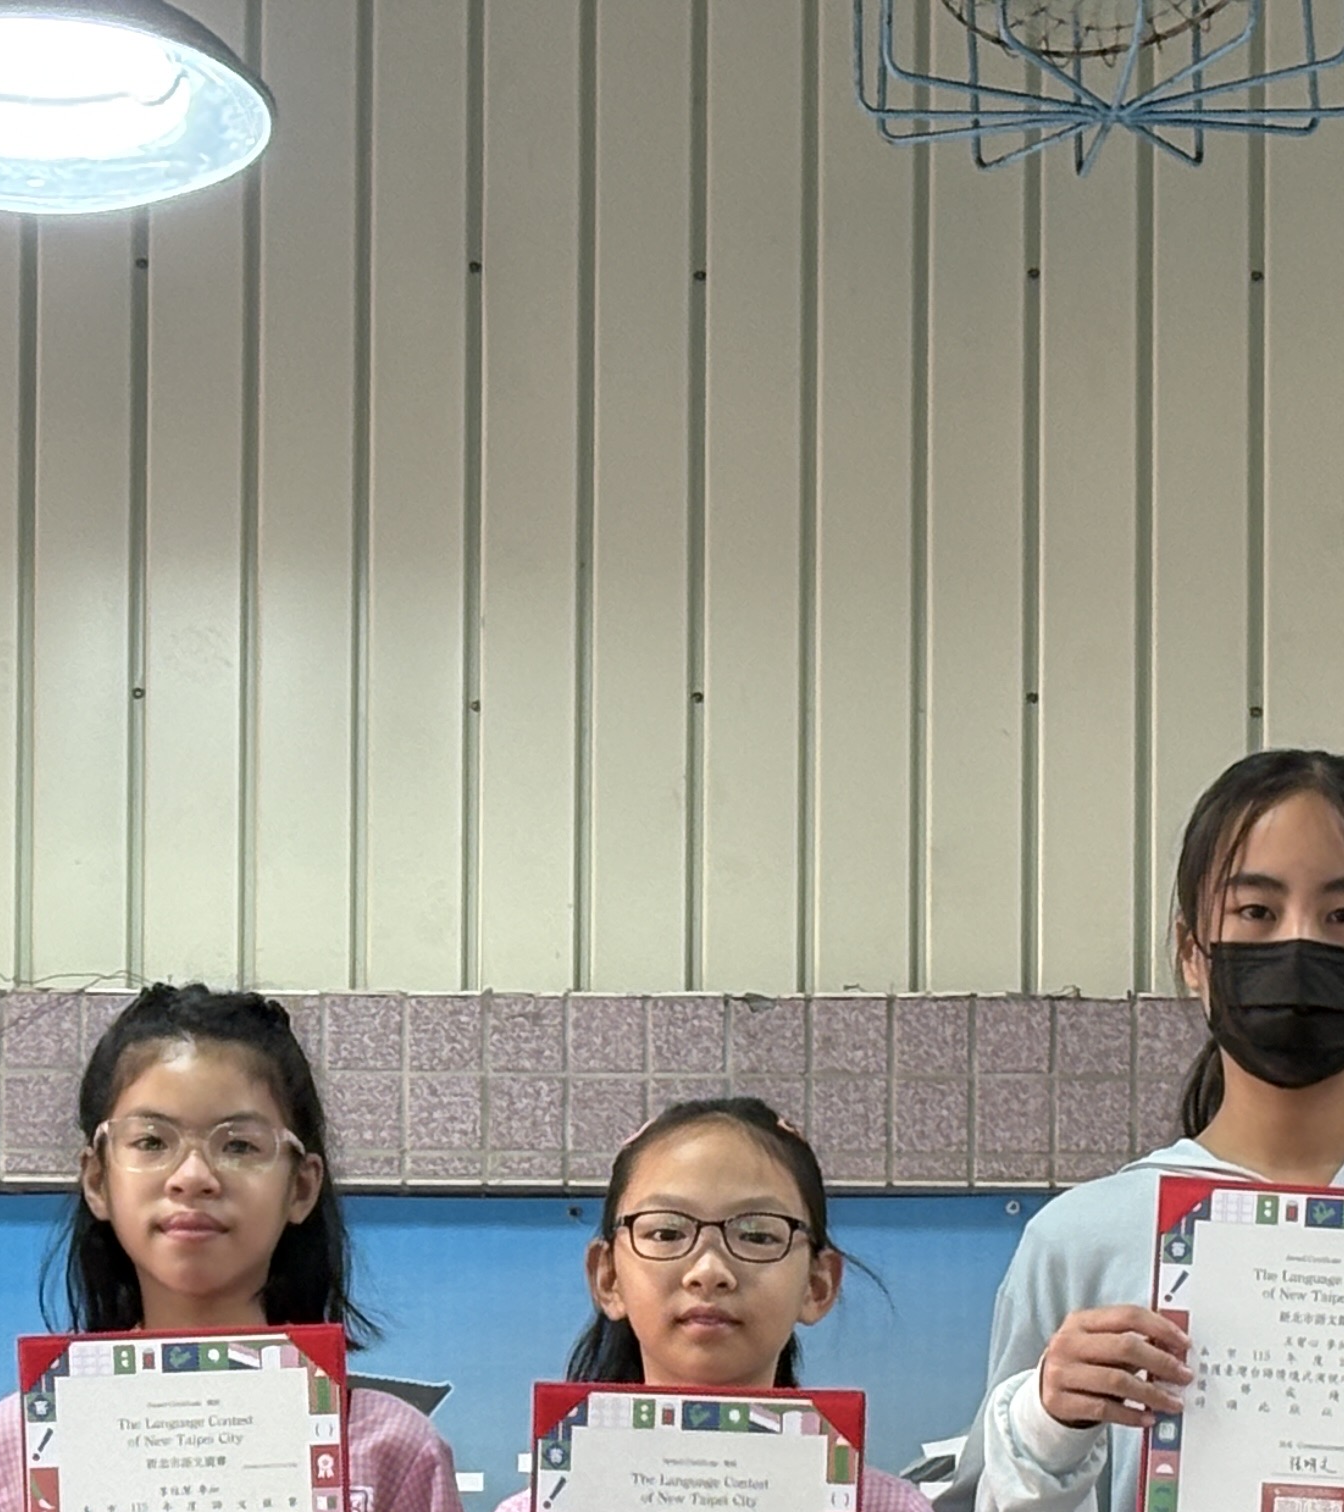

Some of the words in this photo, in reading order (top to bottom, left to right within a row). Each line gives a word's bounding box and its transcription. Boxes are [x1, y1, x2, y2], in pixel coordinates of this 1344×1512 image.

[1253, 1268, 1278, 1282] The
[1282, 1270, 1343, 1287] Language
[1262, 1287, 1277, 1300] of
[1279, 1288, 1307, 1301] New
[118, 1417, 142, 1431] The
[145, 1416, 205, 1431] Language
[208, 1414, 253, 1428] Contest
[127, 1435, 141, 1448] of
[144, 1435, 173, 1448] New
[176, 1433, 214, 1448] Taipei
[218, 1431, 244, 1446] City
[631, 1472, 655, 1487] The
[659, 1473, 720, 1489] Language
[724, 1475, 770, 1491] Contest
[640, 1491, 655, 1503] of
[658, 1491, 685, 1505] New
[690, 1492, 729, 1508] Taipei
[732, 1494, 757, 1509] City
